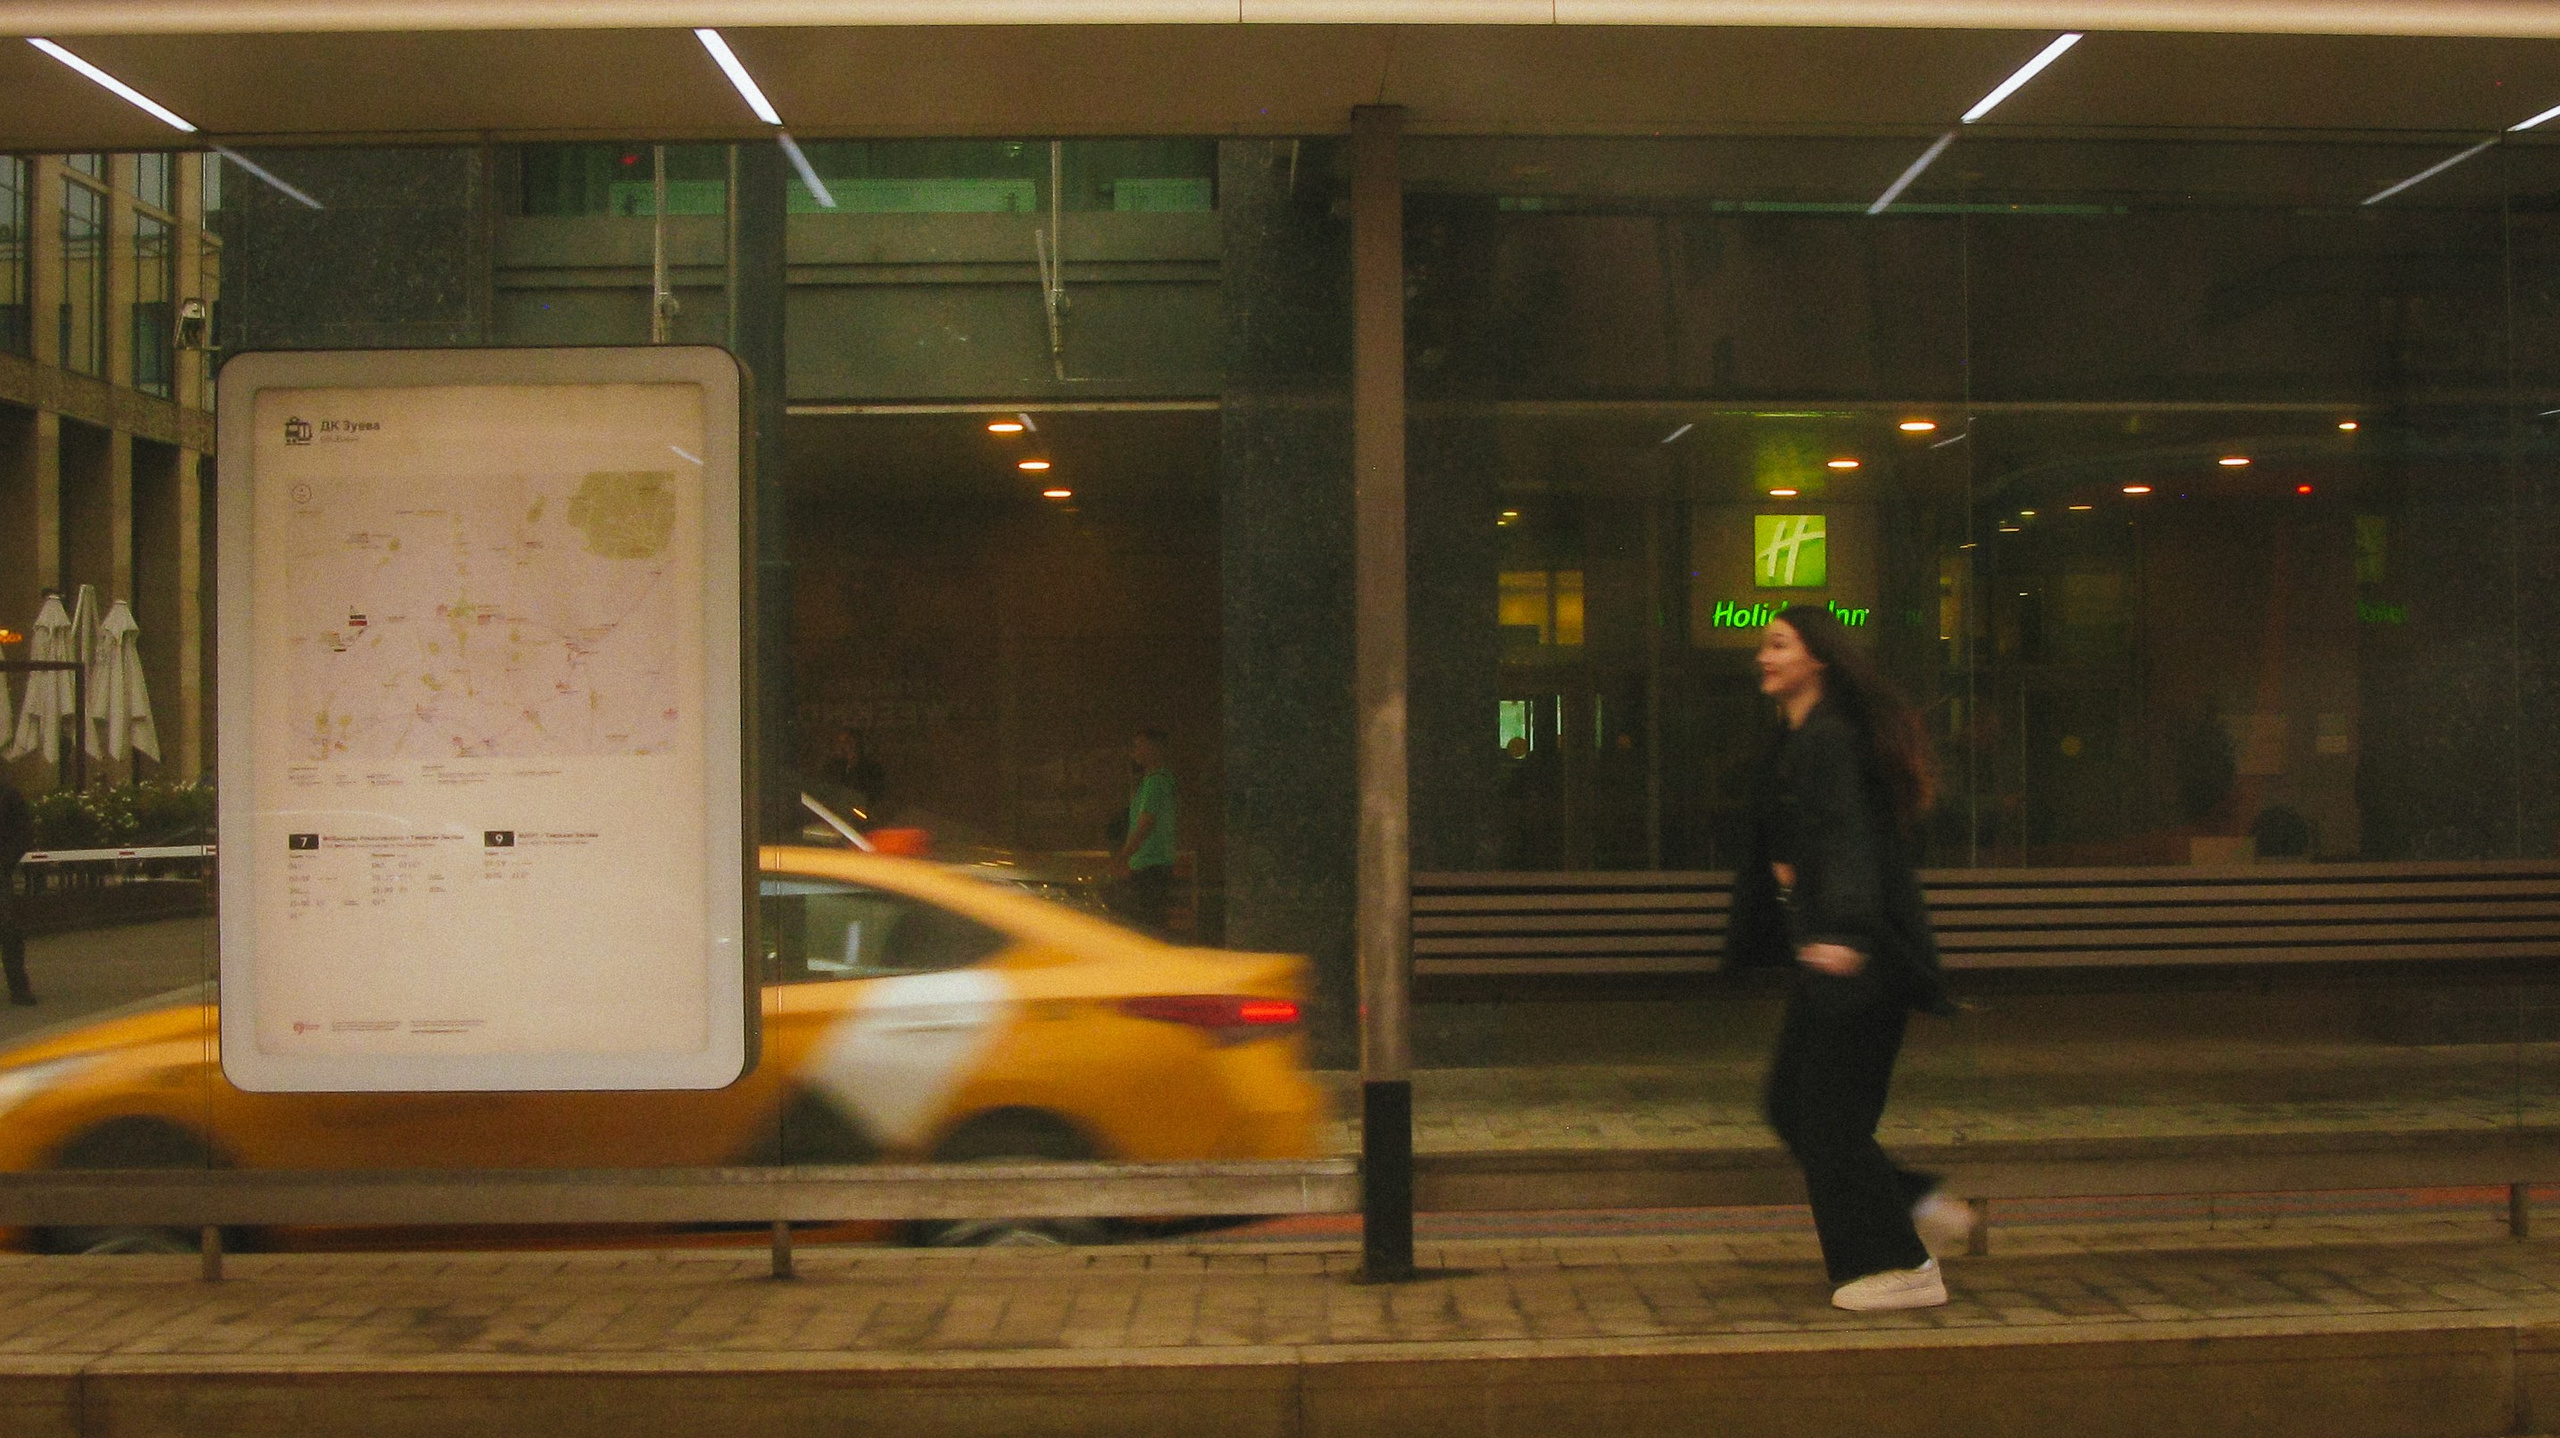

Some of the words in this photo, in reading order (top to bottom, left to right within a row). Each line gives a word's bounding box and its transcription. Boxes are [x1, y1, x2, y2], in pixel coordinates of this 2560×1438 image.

[320, 420, 339, 432] ДК
[342, 419, 381, 433] Зуева
[1713, 600, 1789, 628] Holid
[299, 836, 308, 848] 7
[495, 833, 503, 845] 9
